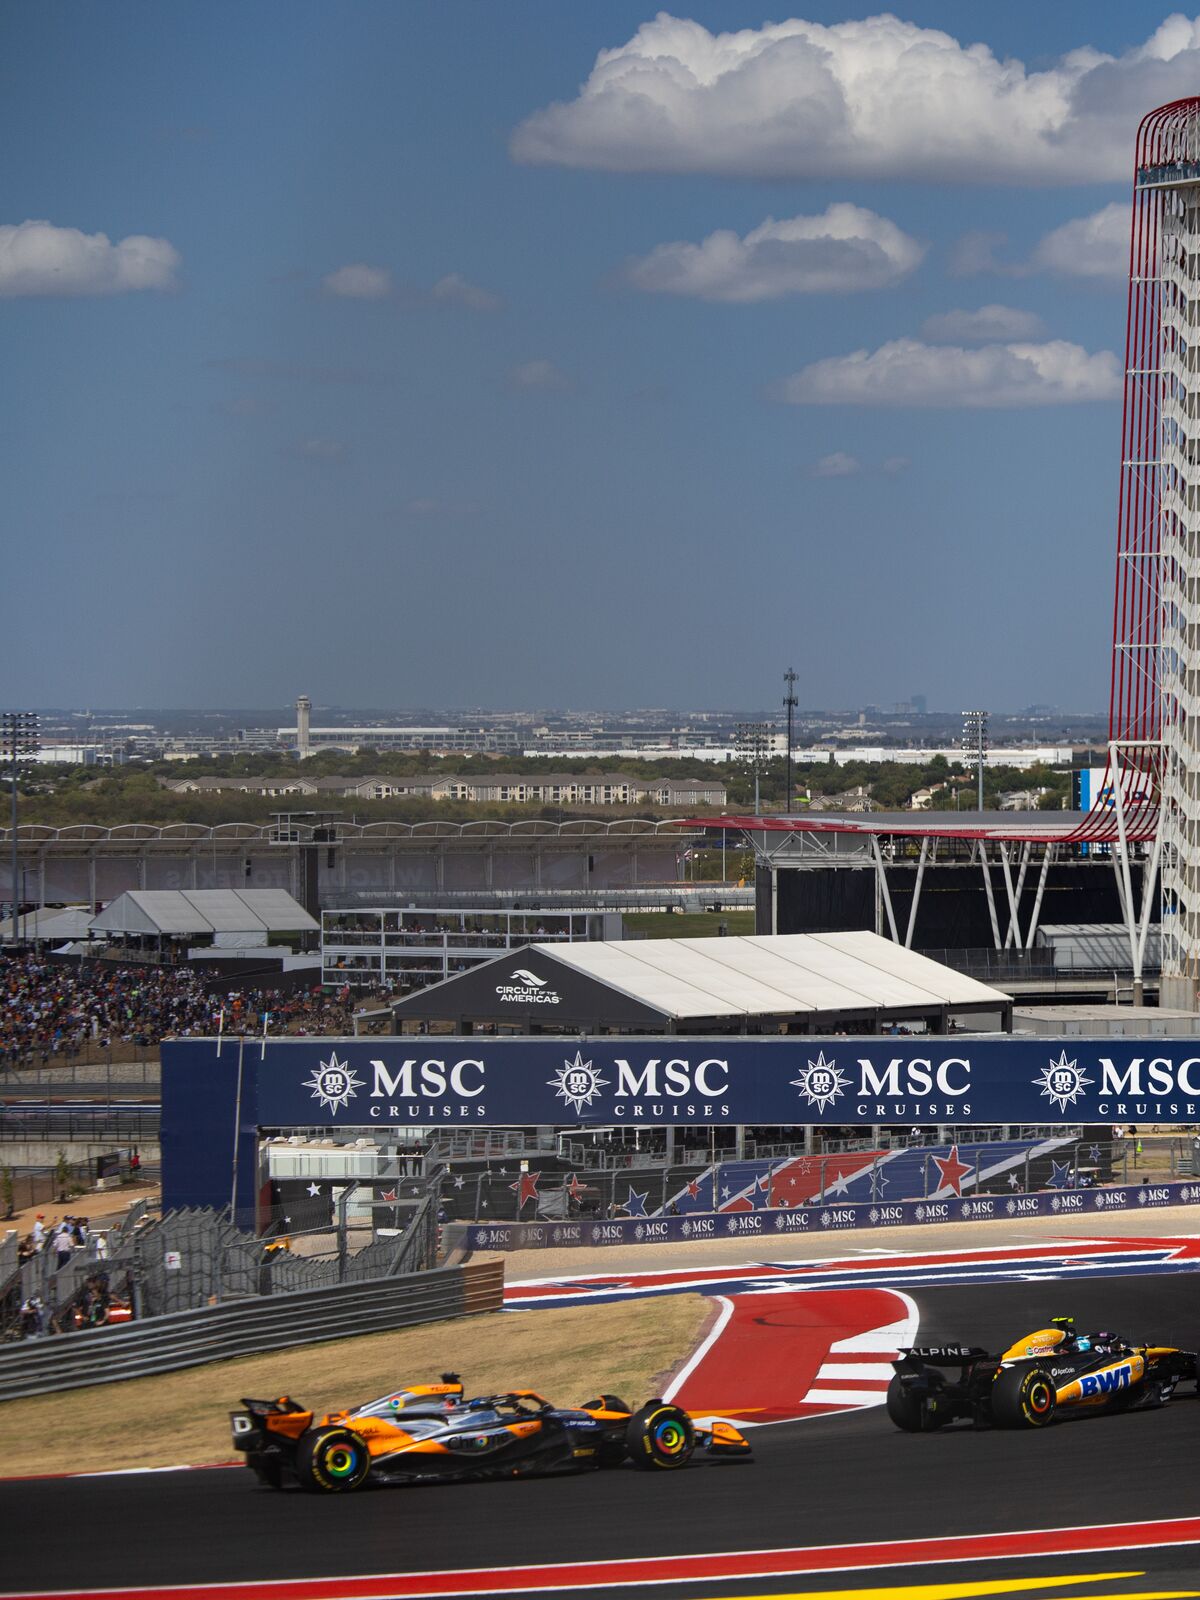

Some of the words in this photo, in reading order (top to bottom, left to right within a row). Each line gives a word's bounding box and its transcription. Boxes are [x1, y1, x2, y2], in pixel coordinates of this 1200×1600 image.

[496, 986, 540, 995] CIRCUIT
[500, 994, 560, 1004] AMERICAS
[370, 1059, 485, 1098] MSC
[615, 1059, 729, 1097] MSC
[857, 1058, 971, 1096] MSC
[370, 1106, 485, 1117] CRUISES
[615, 1105, 728, 1117] CRUISES
[857, 1104, 971, 1116] CRUISES
[1105, 1192, 1126, 1203] MSC
[1149, 1189, 1169, 1200] MSC
[972, 1201, 993, 1213] MSC
[1017, 1198, 1038, 1210] MSC
[1062, 1196, 1083, 1206] MSC
[832, 1210, 855, 1222] MSC
[881, 1207, 902, 1219] MSC
[926, 1204, 948, 1216] MSC
[739, 1217, 761, 1228] MSC
[786, 1213, 808, 1225] MSC
[602, 1225, 623, 1238] MSC
[646, 1223, 667, 1235] MSC
[693, 1220, 714, 1232] MSC
[490, 1230, 511, 1242] MSC
[527, 1228, 543, 1240] MSC
[563, 1227, 581, 1239] MSC
[909, 1348, 971, 1357] ALPINE
[1080, 1364, 1132, 1399] BWT
